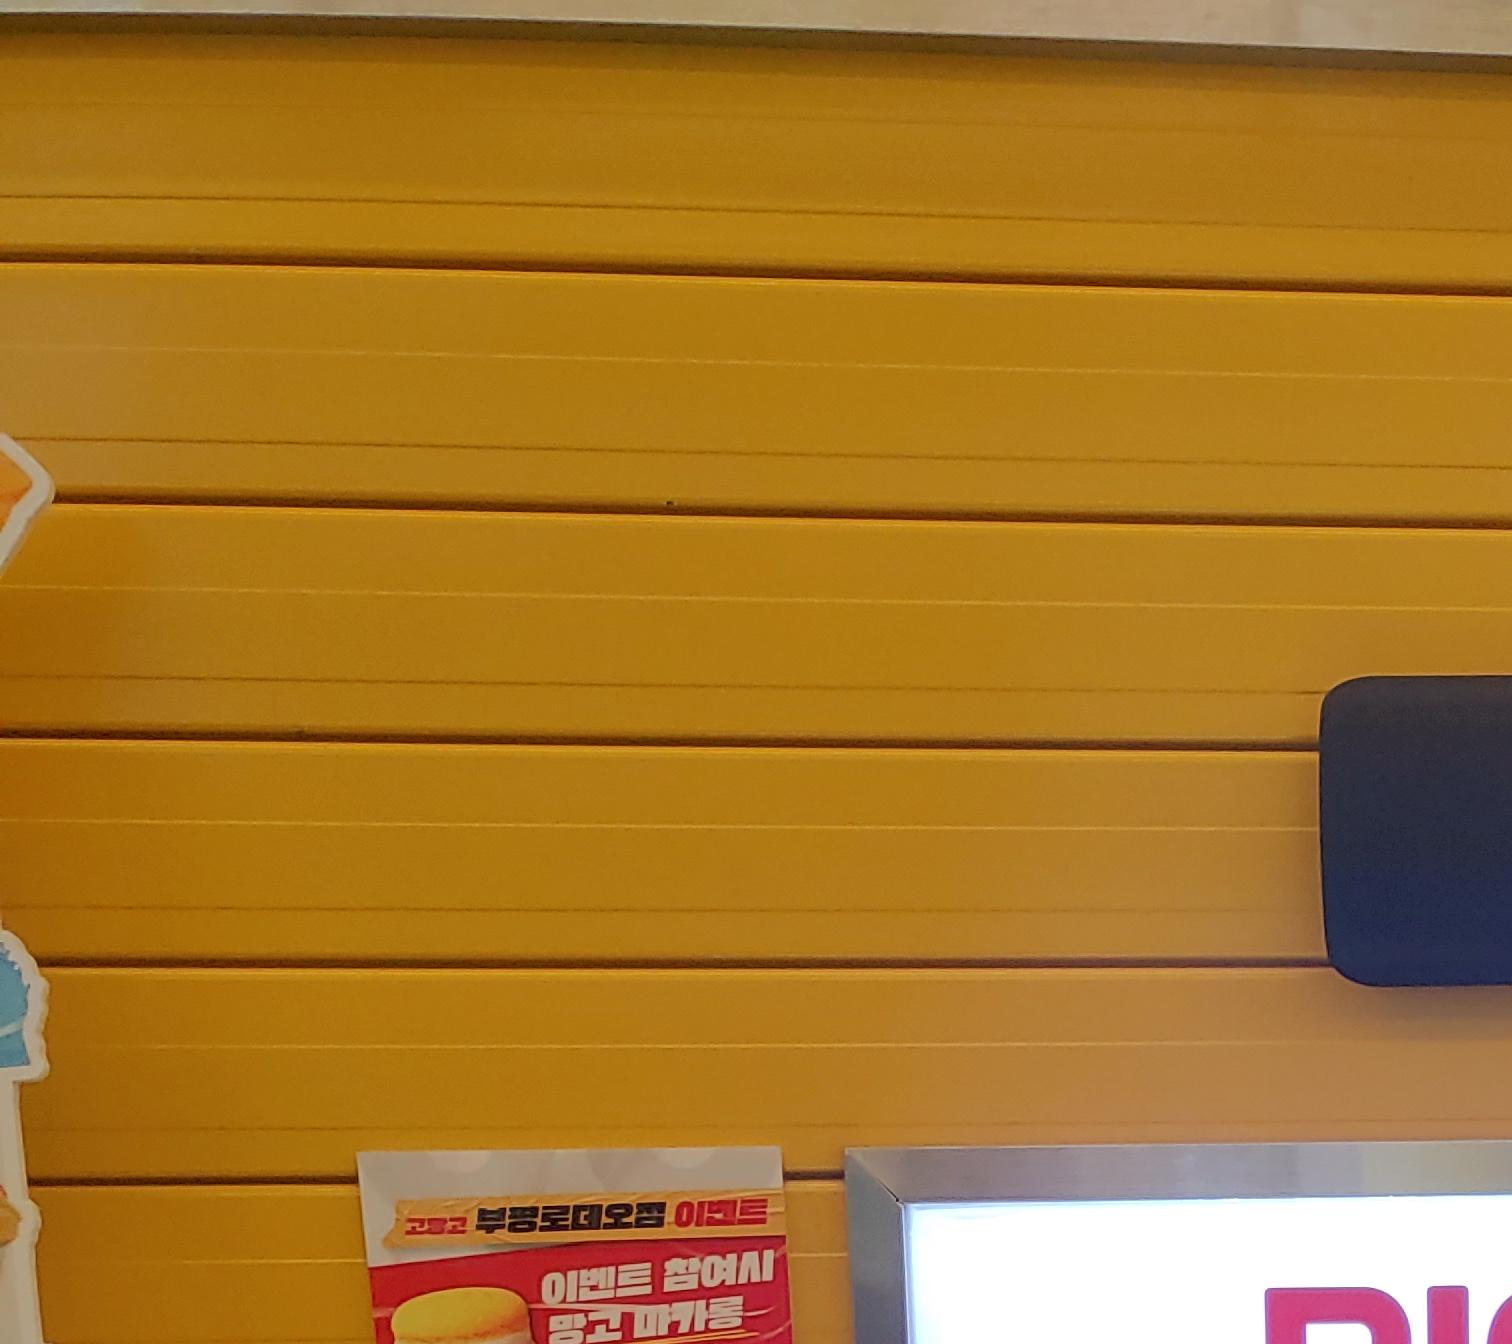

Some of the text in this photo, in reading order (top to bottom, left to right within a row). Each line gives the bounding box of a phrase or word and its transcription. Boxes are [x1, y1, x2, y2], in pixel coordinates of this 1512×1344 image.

[475, 1201, 667, 1236] 부평로데오점
[674, 1198, 769, 1229] 이벤트
[540, 1249, 776, 1307] 이벤트 참여시
[632, 1295, 744, 1341] 마카롱
